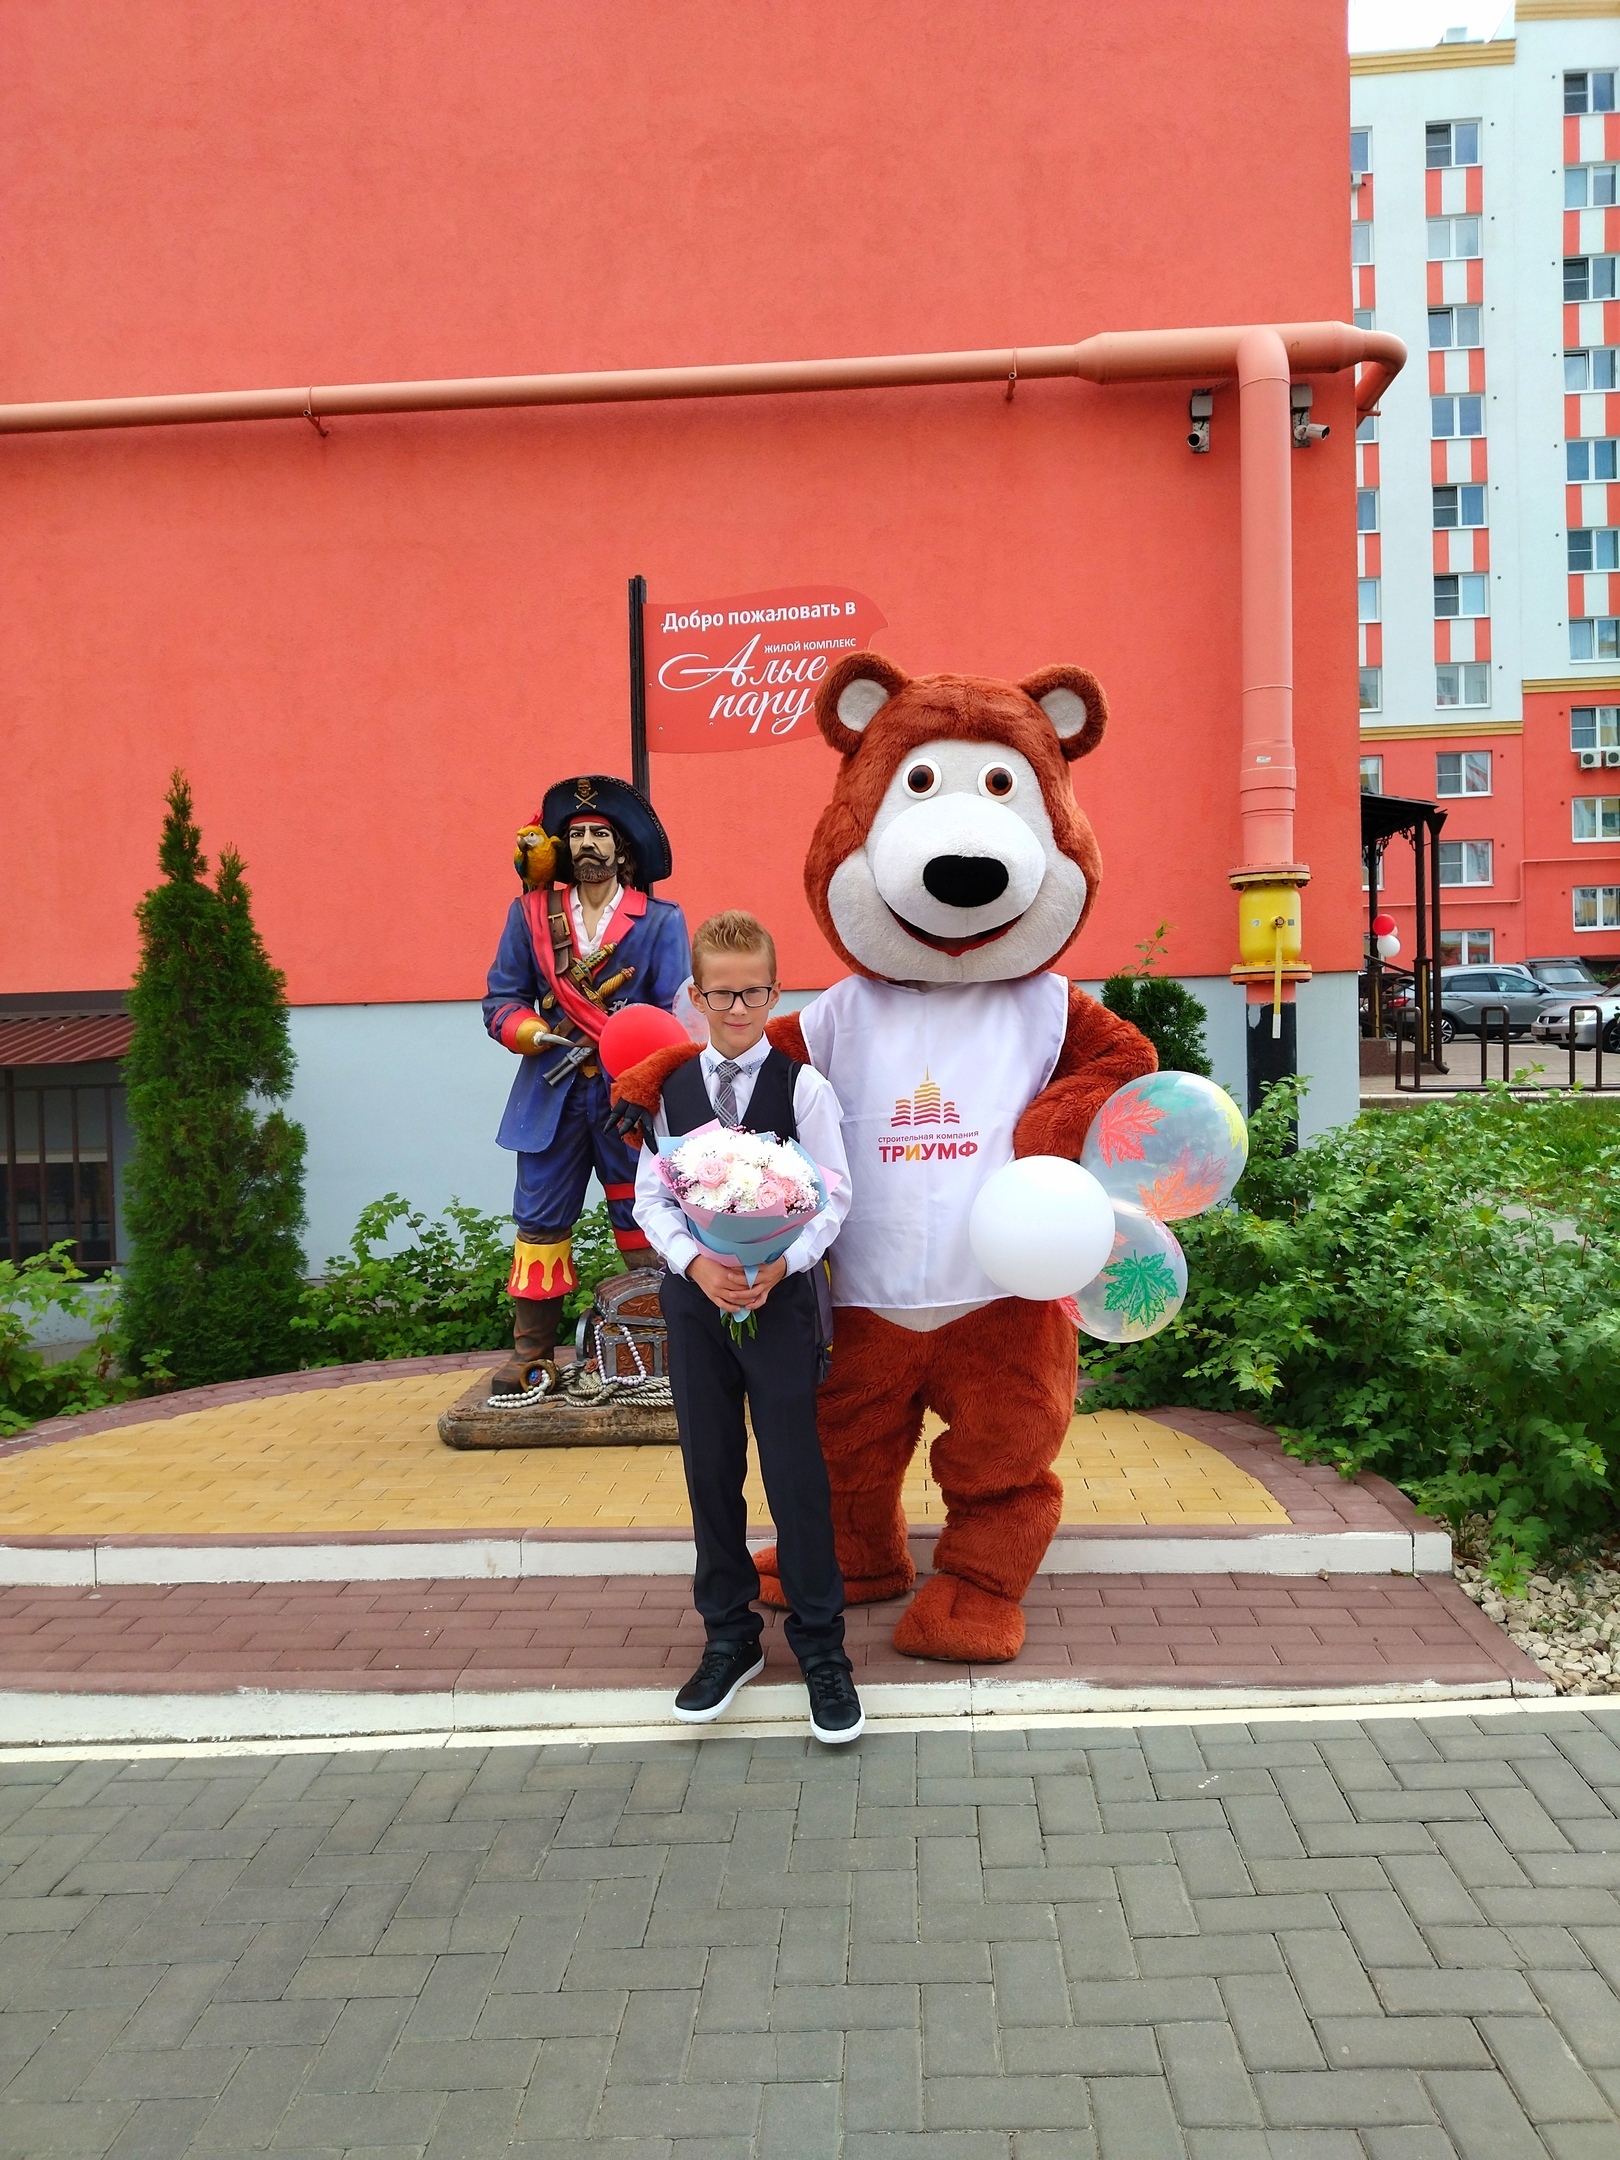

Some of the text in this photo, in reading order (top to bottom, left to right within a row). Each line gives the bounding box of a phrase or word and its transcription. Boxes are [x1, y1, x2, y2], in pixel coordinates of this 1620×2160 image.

[663, 602, 856, 633] Добро пожаловать в
[764, 638, 857, 653] ЖИЛОЙ КОМПЛЕКС
[658, 633, 828, 690] Алые
[709, 687, 815, 734] пару
[878, 1130, 979, 1144] строительная компания
[878, 1141, 978, 1163] ТРИУМФ
